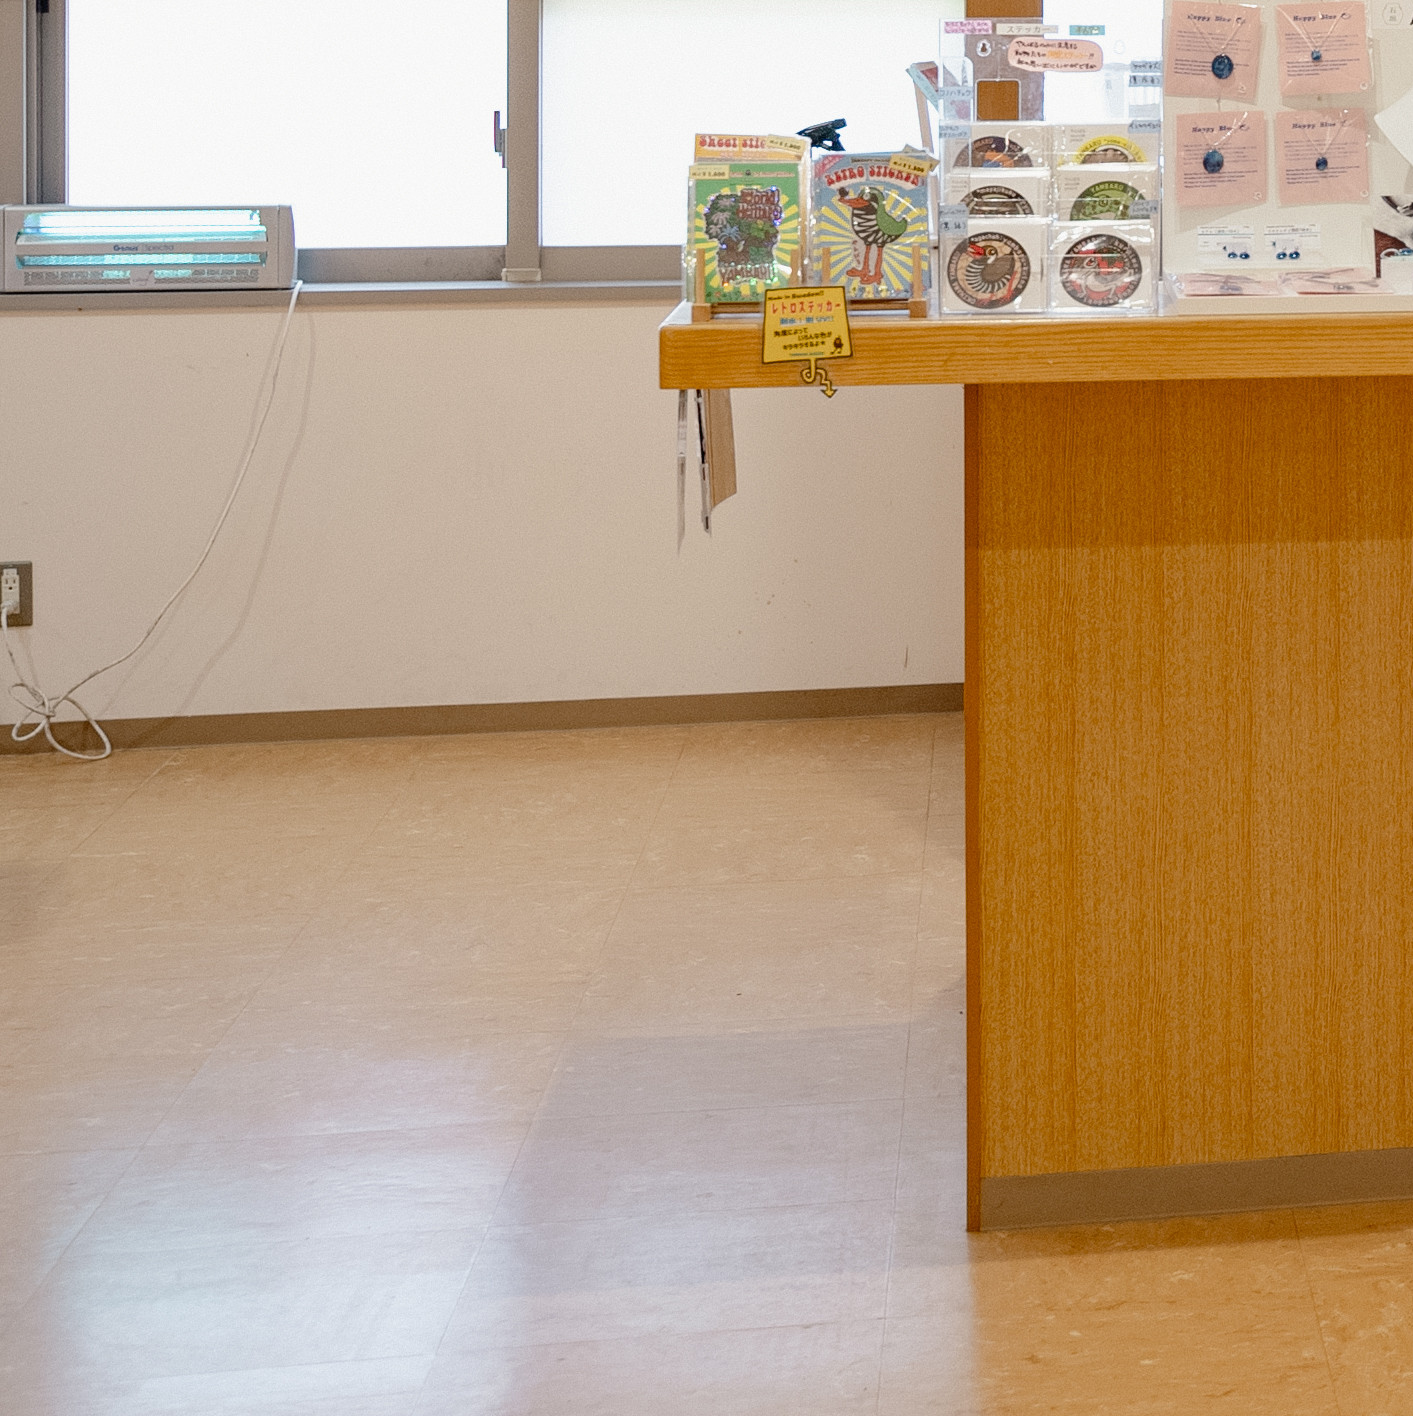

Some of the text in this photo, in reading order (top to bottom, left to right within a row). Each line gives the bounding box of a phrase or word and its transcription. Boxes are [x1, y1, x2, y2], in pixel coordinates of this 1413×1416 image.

[742, 137, 768, 149] stic
[772, 300, 841, 314] レトロステッカー
